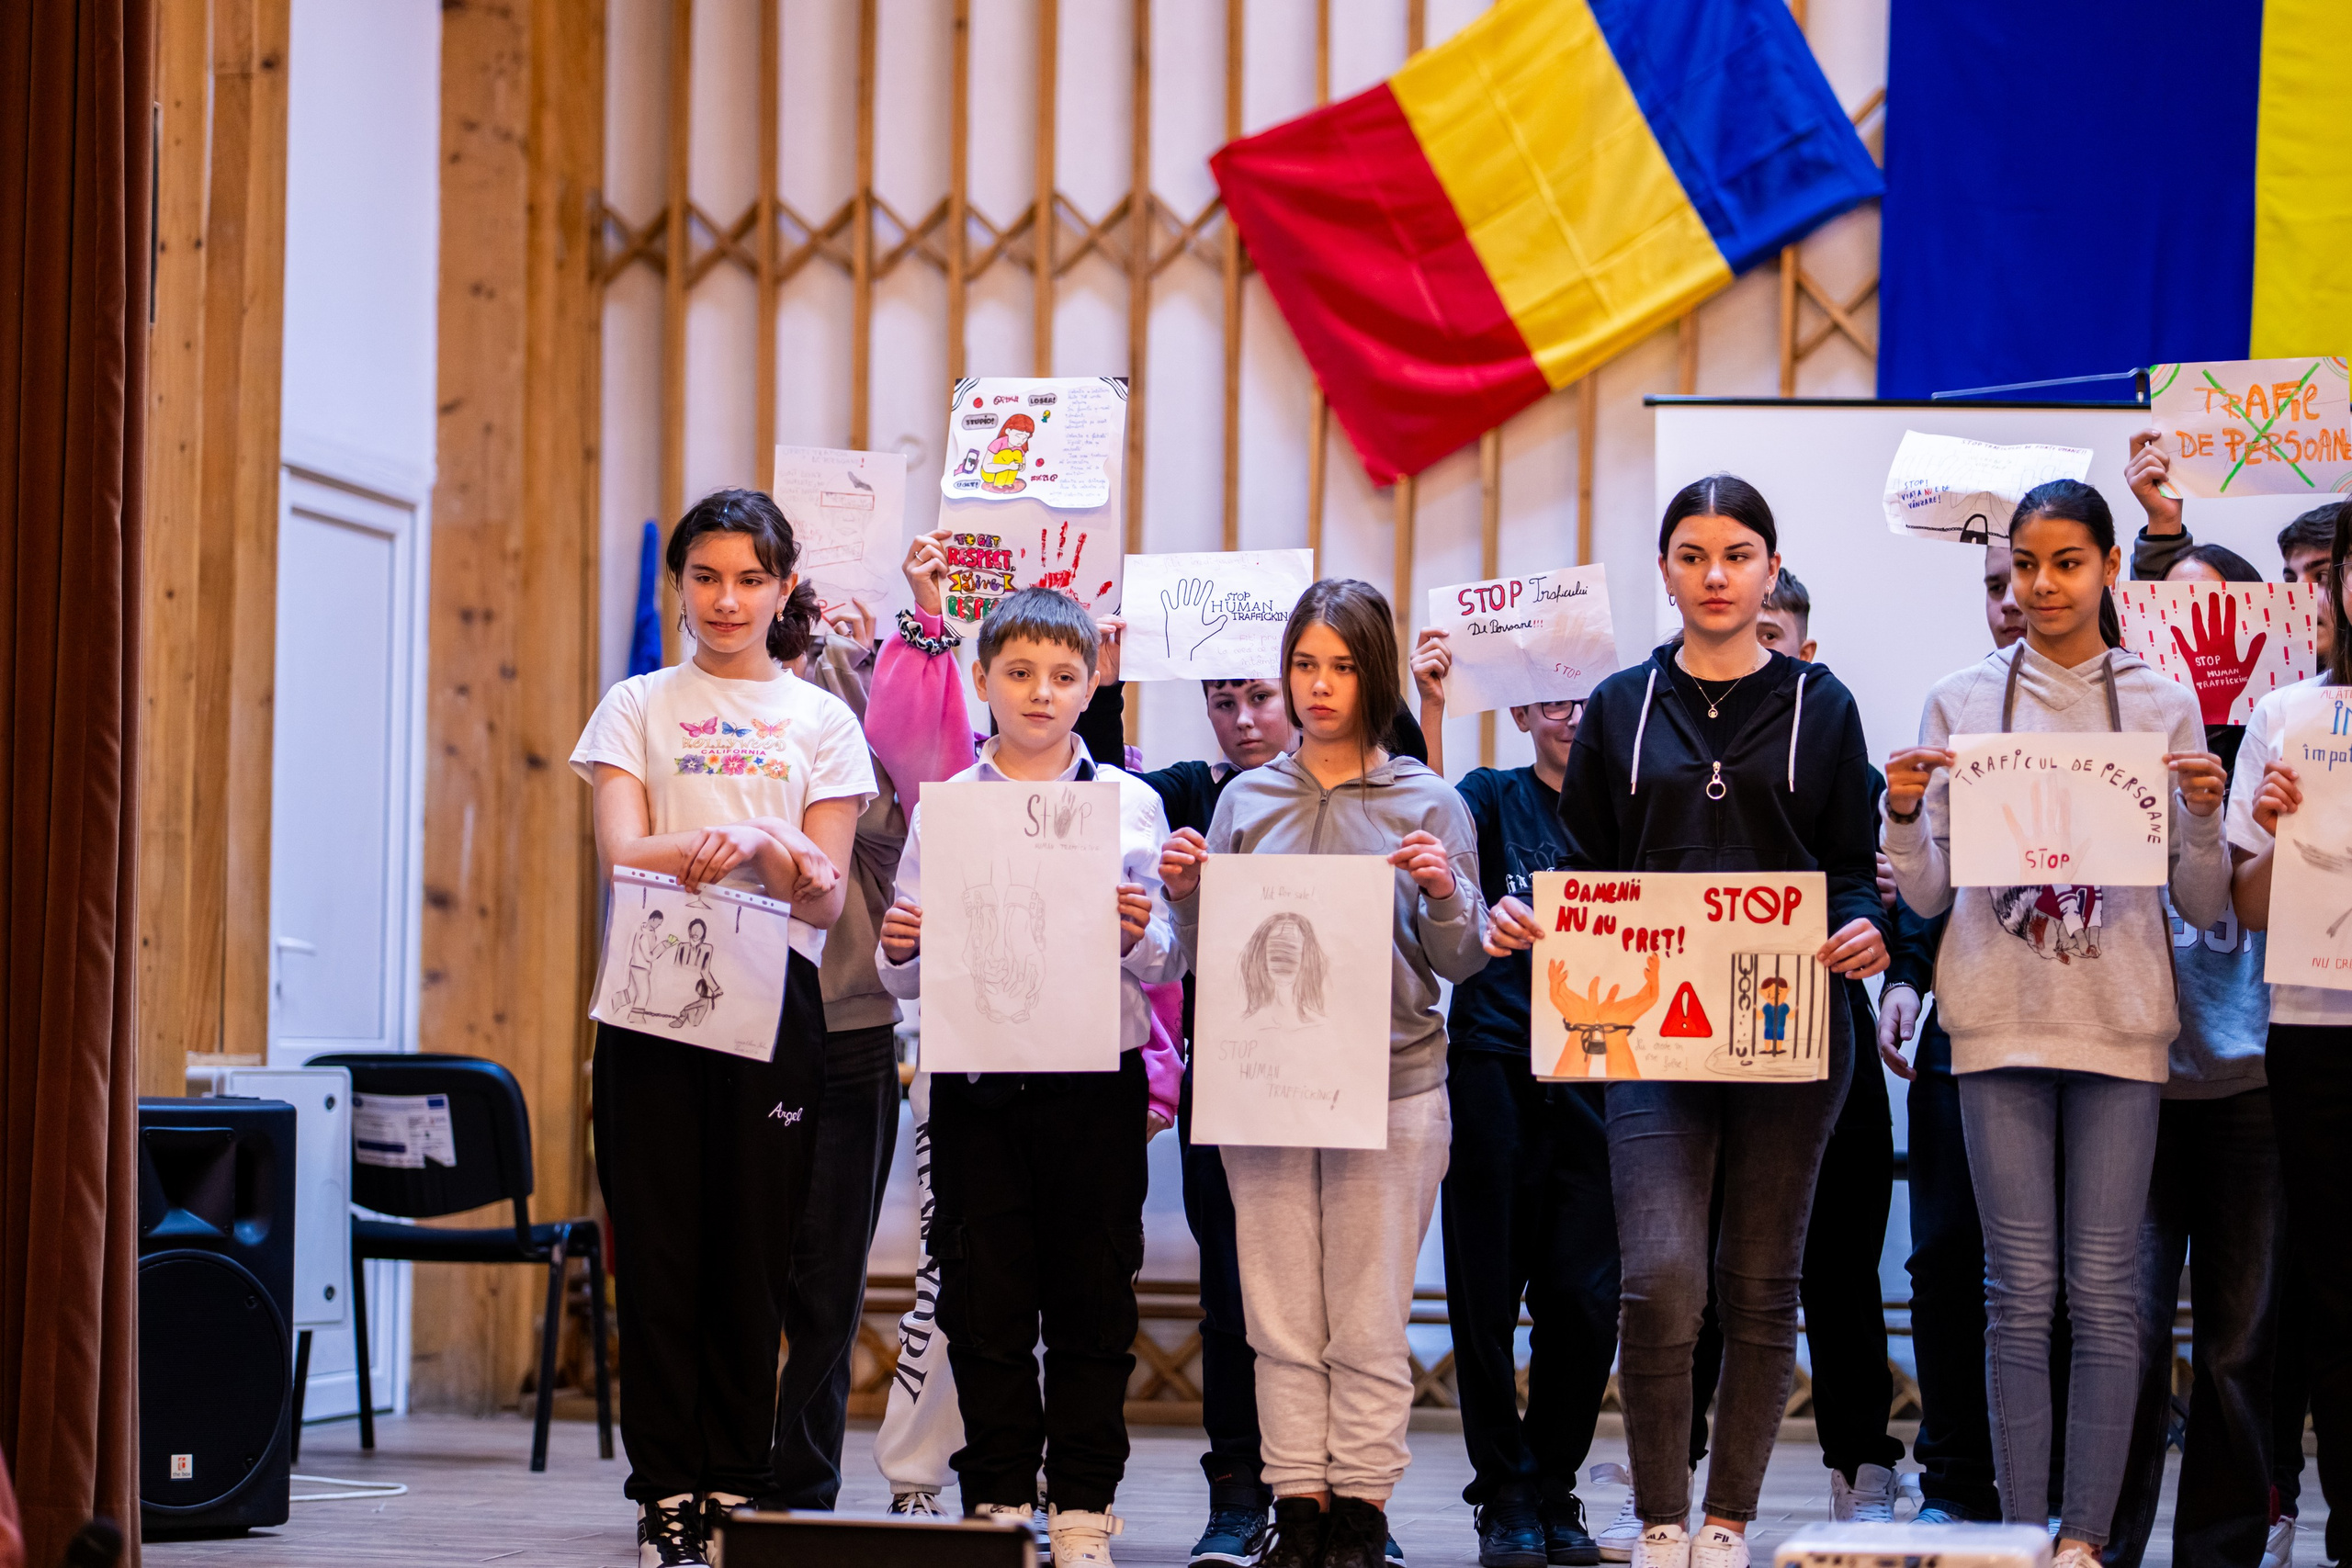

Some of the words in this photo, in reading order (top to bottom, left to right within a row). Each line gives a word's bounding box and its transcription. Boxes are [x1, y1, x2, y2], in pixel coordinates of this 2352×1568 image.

[2176, 430, 2214, 458] DE
[1904, 479, 1928, 491] STOP!
[1924, 488, 1933, 496] NU
[954, 533, 976, 547] TO
[978, 533, 1001, 547] GET
[1225, 591, 1251, 602] STOP
[1457, 580, 1523, 616] STOP
[1211, 599, 1273, 614] HUMAN
[1231, 611, 1294, 622] TRAFFICKIN
[2195, 655, 2222, 667] STOP
[1554, 662, 1581, 680] STOP
[2207, 668, 2240, 678] HUMAN
[2071, 759, 2093, 772] DE
[2100, 762, 2163, 844] PERSOANE
[2025, 848, 2070, 870] STOP
[1703, 886, 1802, 926] STOP
[1555, 906, 1588, 932] NU
[1592, 914, 1617, 936] AU
[2312, 957, 2330, 969] NU
[1218, 1040, 1258, 1061] STOP
[1240, 1062, 1280, 1080] HUMAN
